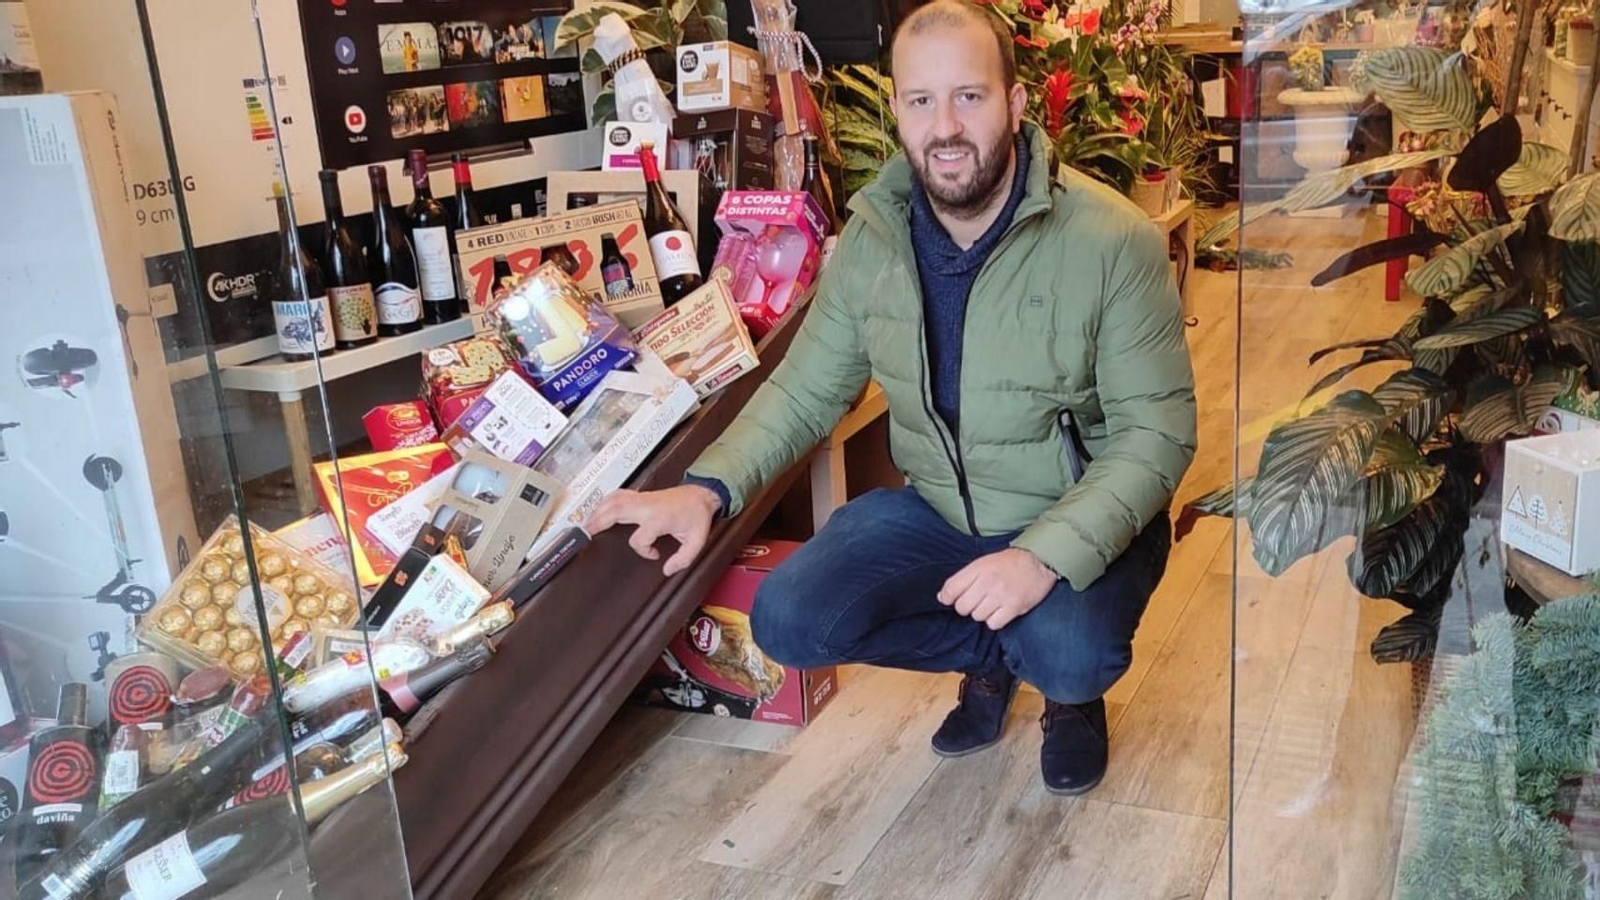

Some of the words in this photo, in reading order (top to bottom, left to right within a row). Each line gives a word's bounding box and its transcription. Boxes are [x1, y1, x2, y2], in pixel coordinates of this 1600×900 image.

[133, 175, 196, 200] D63G
[732, 196, 741, 205] 6
[743, 194, 793, 205] COPAS
[136, 208, 146, 226] 9
[151, 208, 175, 223] cm
[727, 206, 788, 216] DISTINTAS
[467, 239, 475, 249] 4
[477, 234, 505, 248] RED
[565, 220, 572, 230] 2
[592, 211, 616, 225] IRISH
[553, 347, 608, 391] PANDORO
[36, 812, 75, 825] daviña
